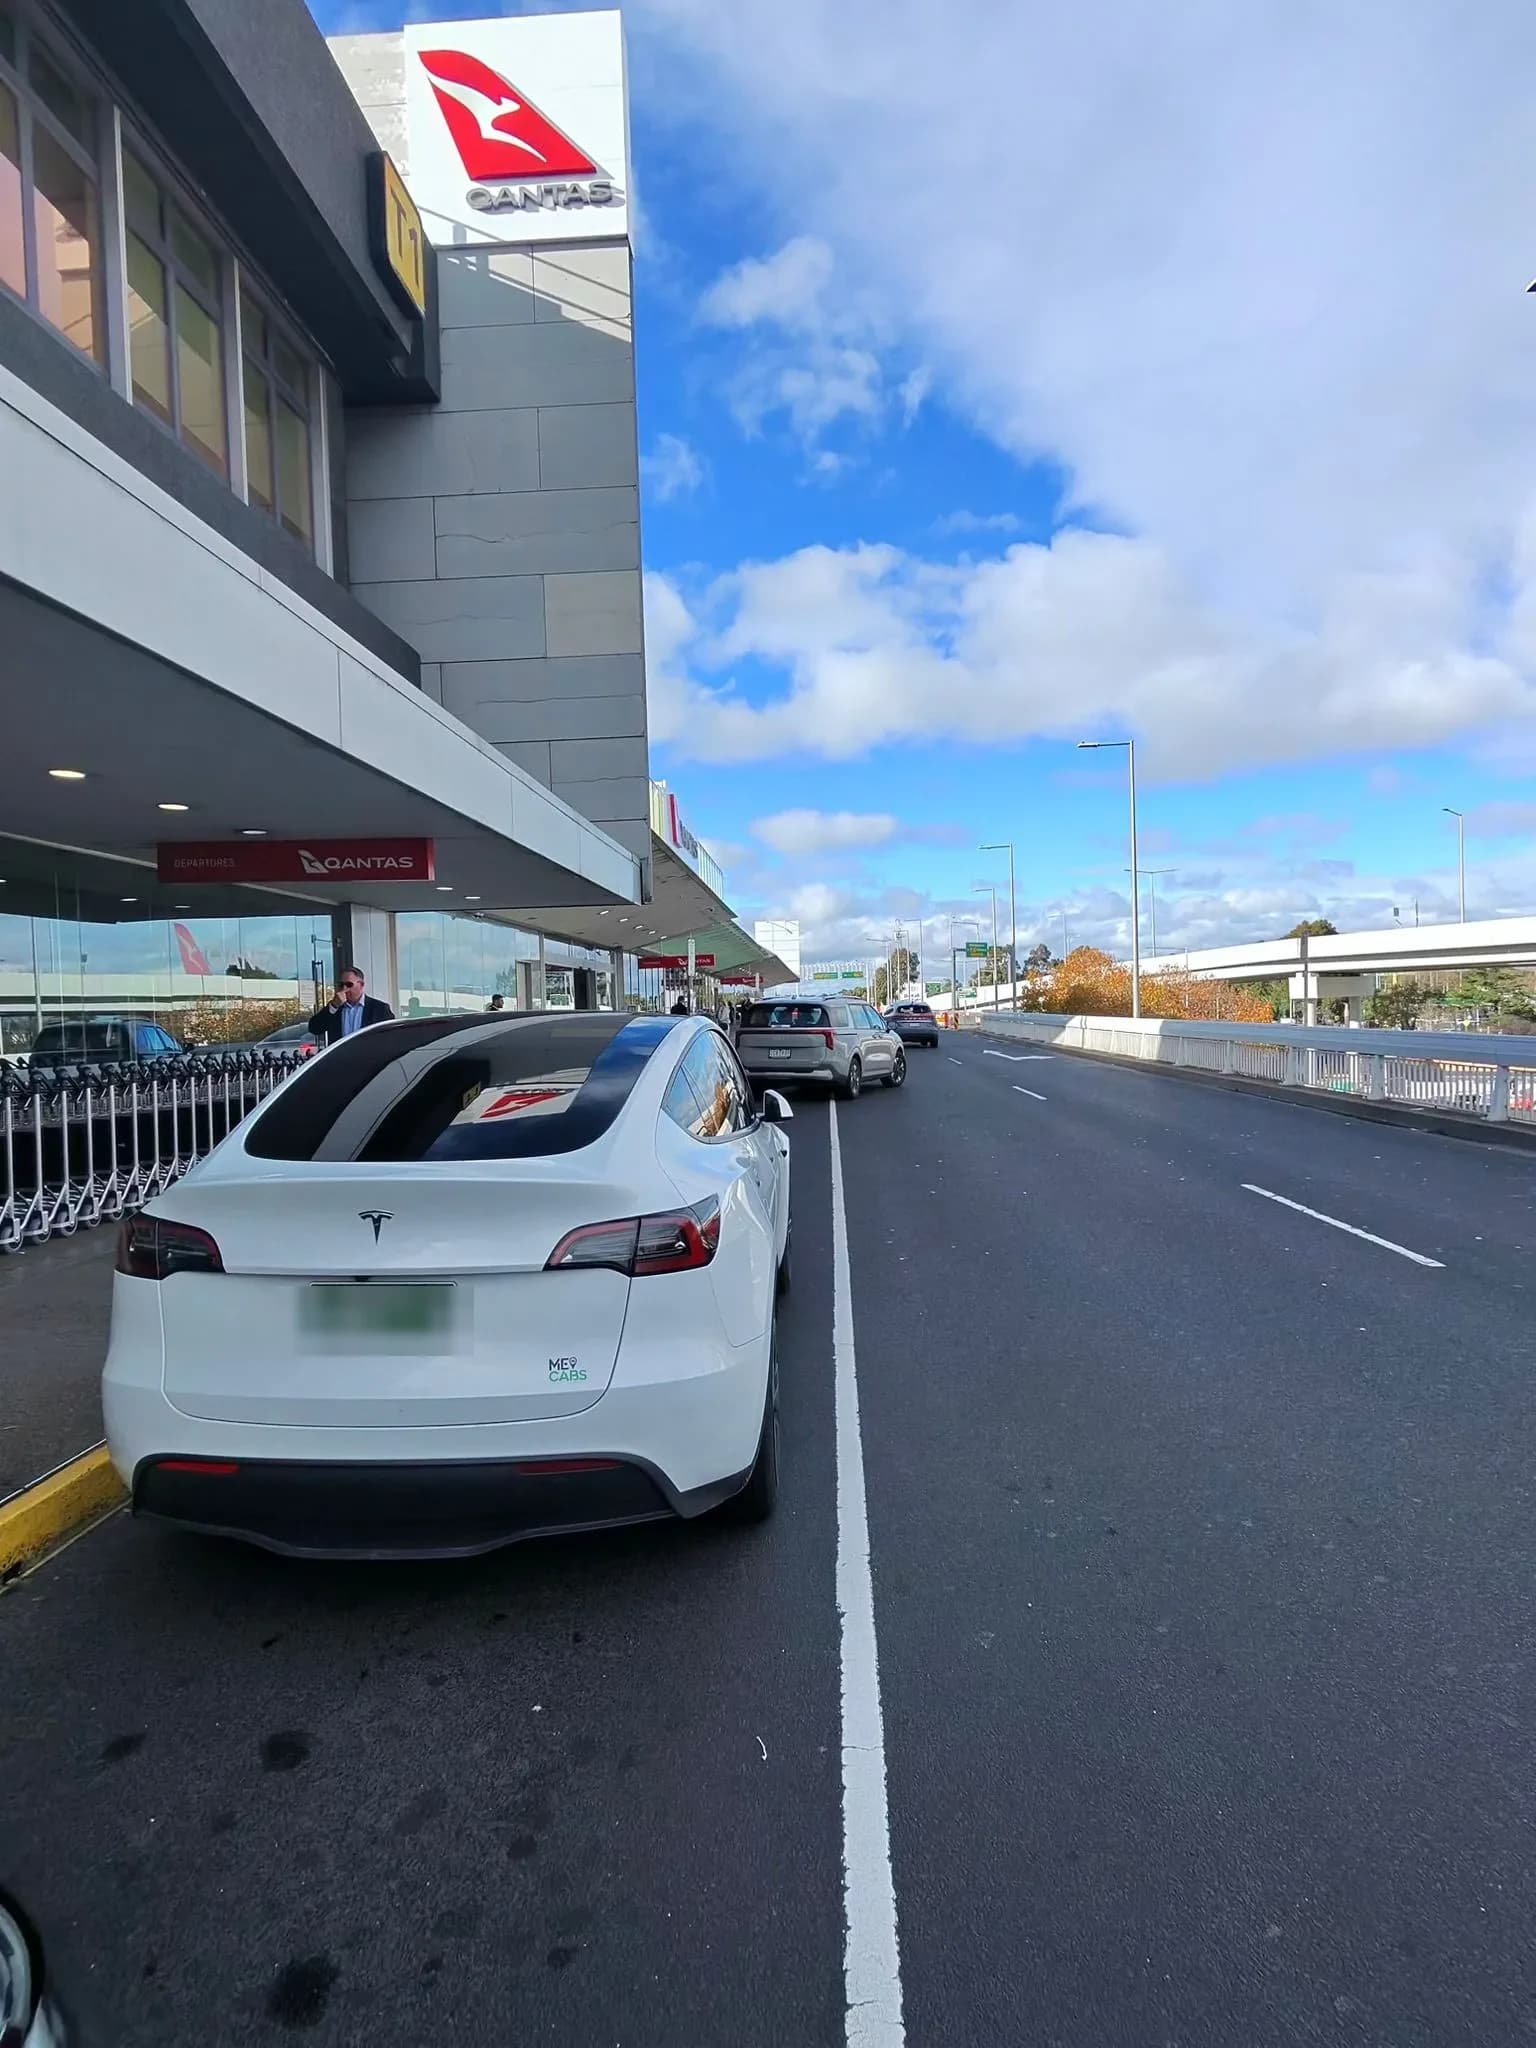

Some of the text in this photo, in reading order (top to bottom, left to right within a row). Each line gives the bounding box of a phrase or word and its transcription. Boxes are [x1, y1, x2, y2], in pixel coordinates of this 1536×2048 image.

[465, 181, 613, 210] QANTAS
[389, 183, 420, 290] T1
[173, 856, 414, 869] DEPARTURES QANTAS
[549, 1370, 587, 1382] CABS
